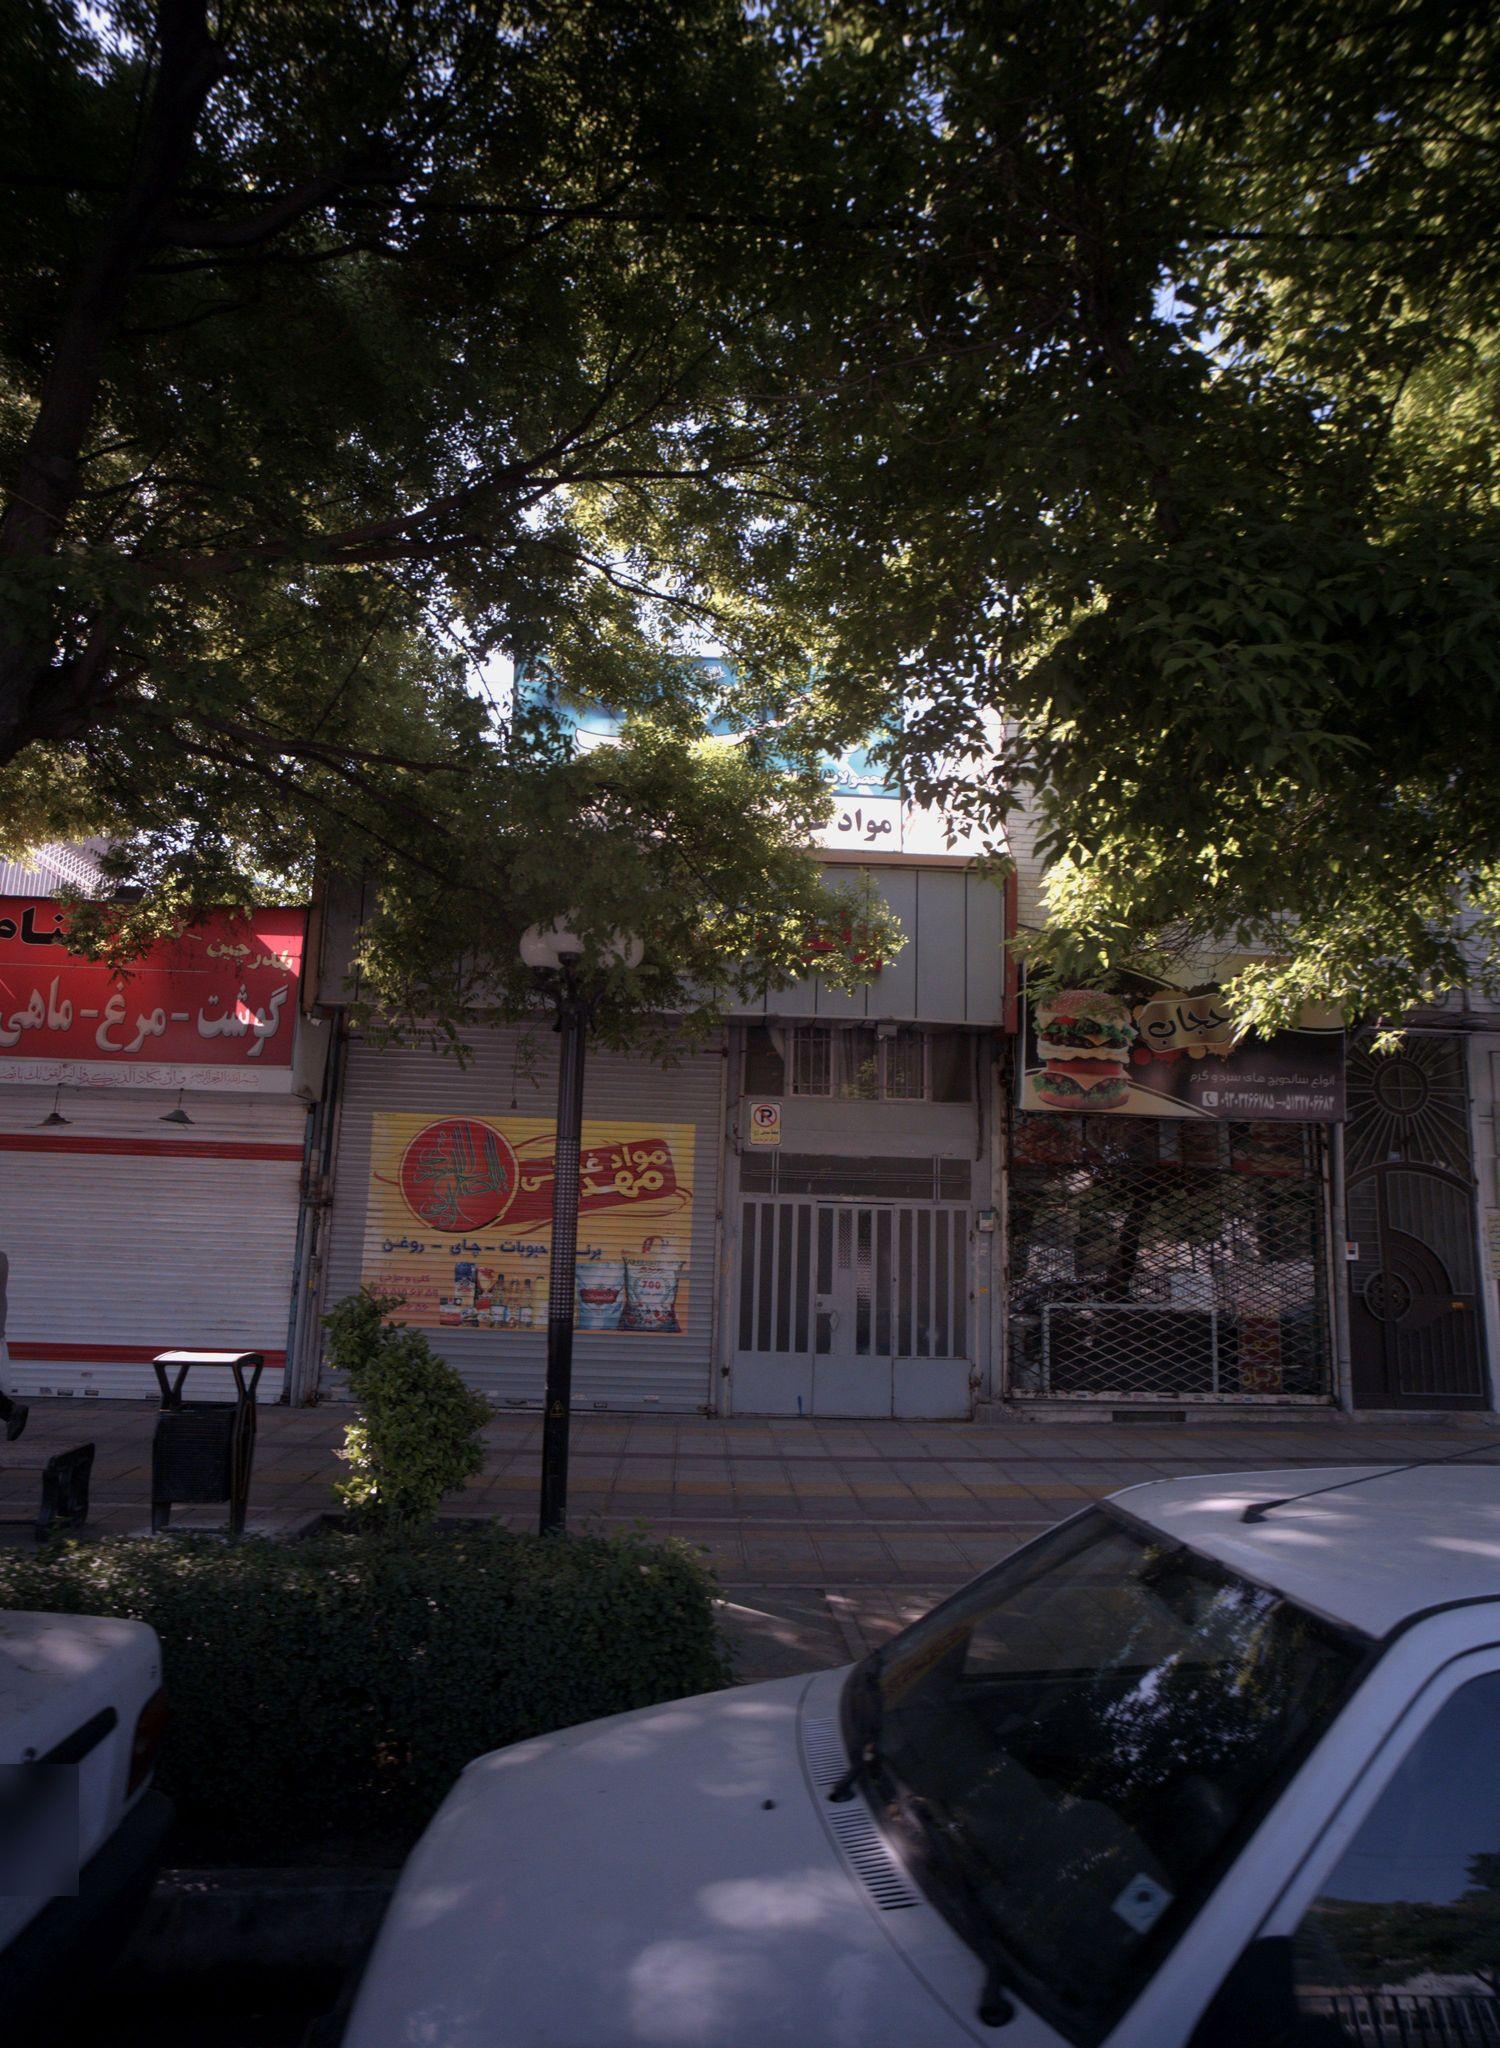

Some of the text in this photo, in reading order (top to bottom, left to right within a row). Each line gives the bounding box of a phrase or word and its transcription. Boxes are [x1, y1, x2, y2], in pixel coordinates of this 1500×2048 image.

[838, 808, 892, 842] مواد
[0, 976, 288, 1057] گوشت مرغ ماهی
[610, 1145, 668, 1174] مواد
[382, 1236, 425, 1253] روغن
[449, 1239, 482, 1257] چای
